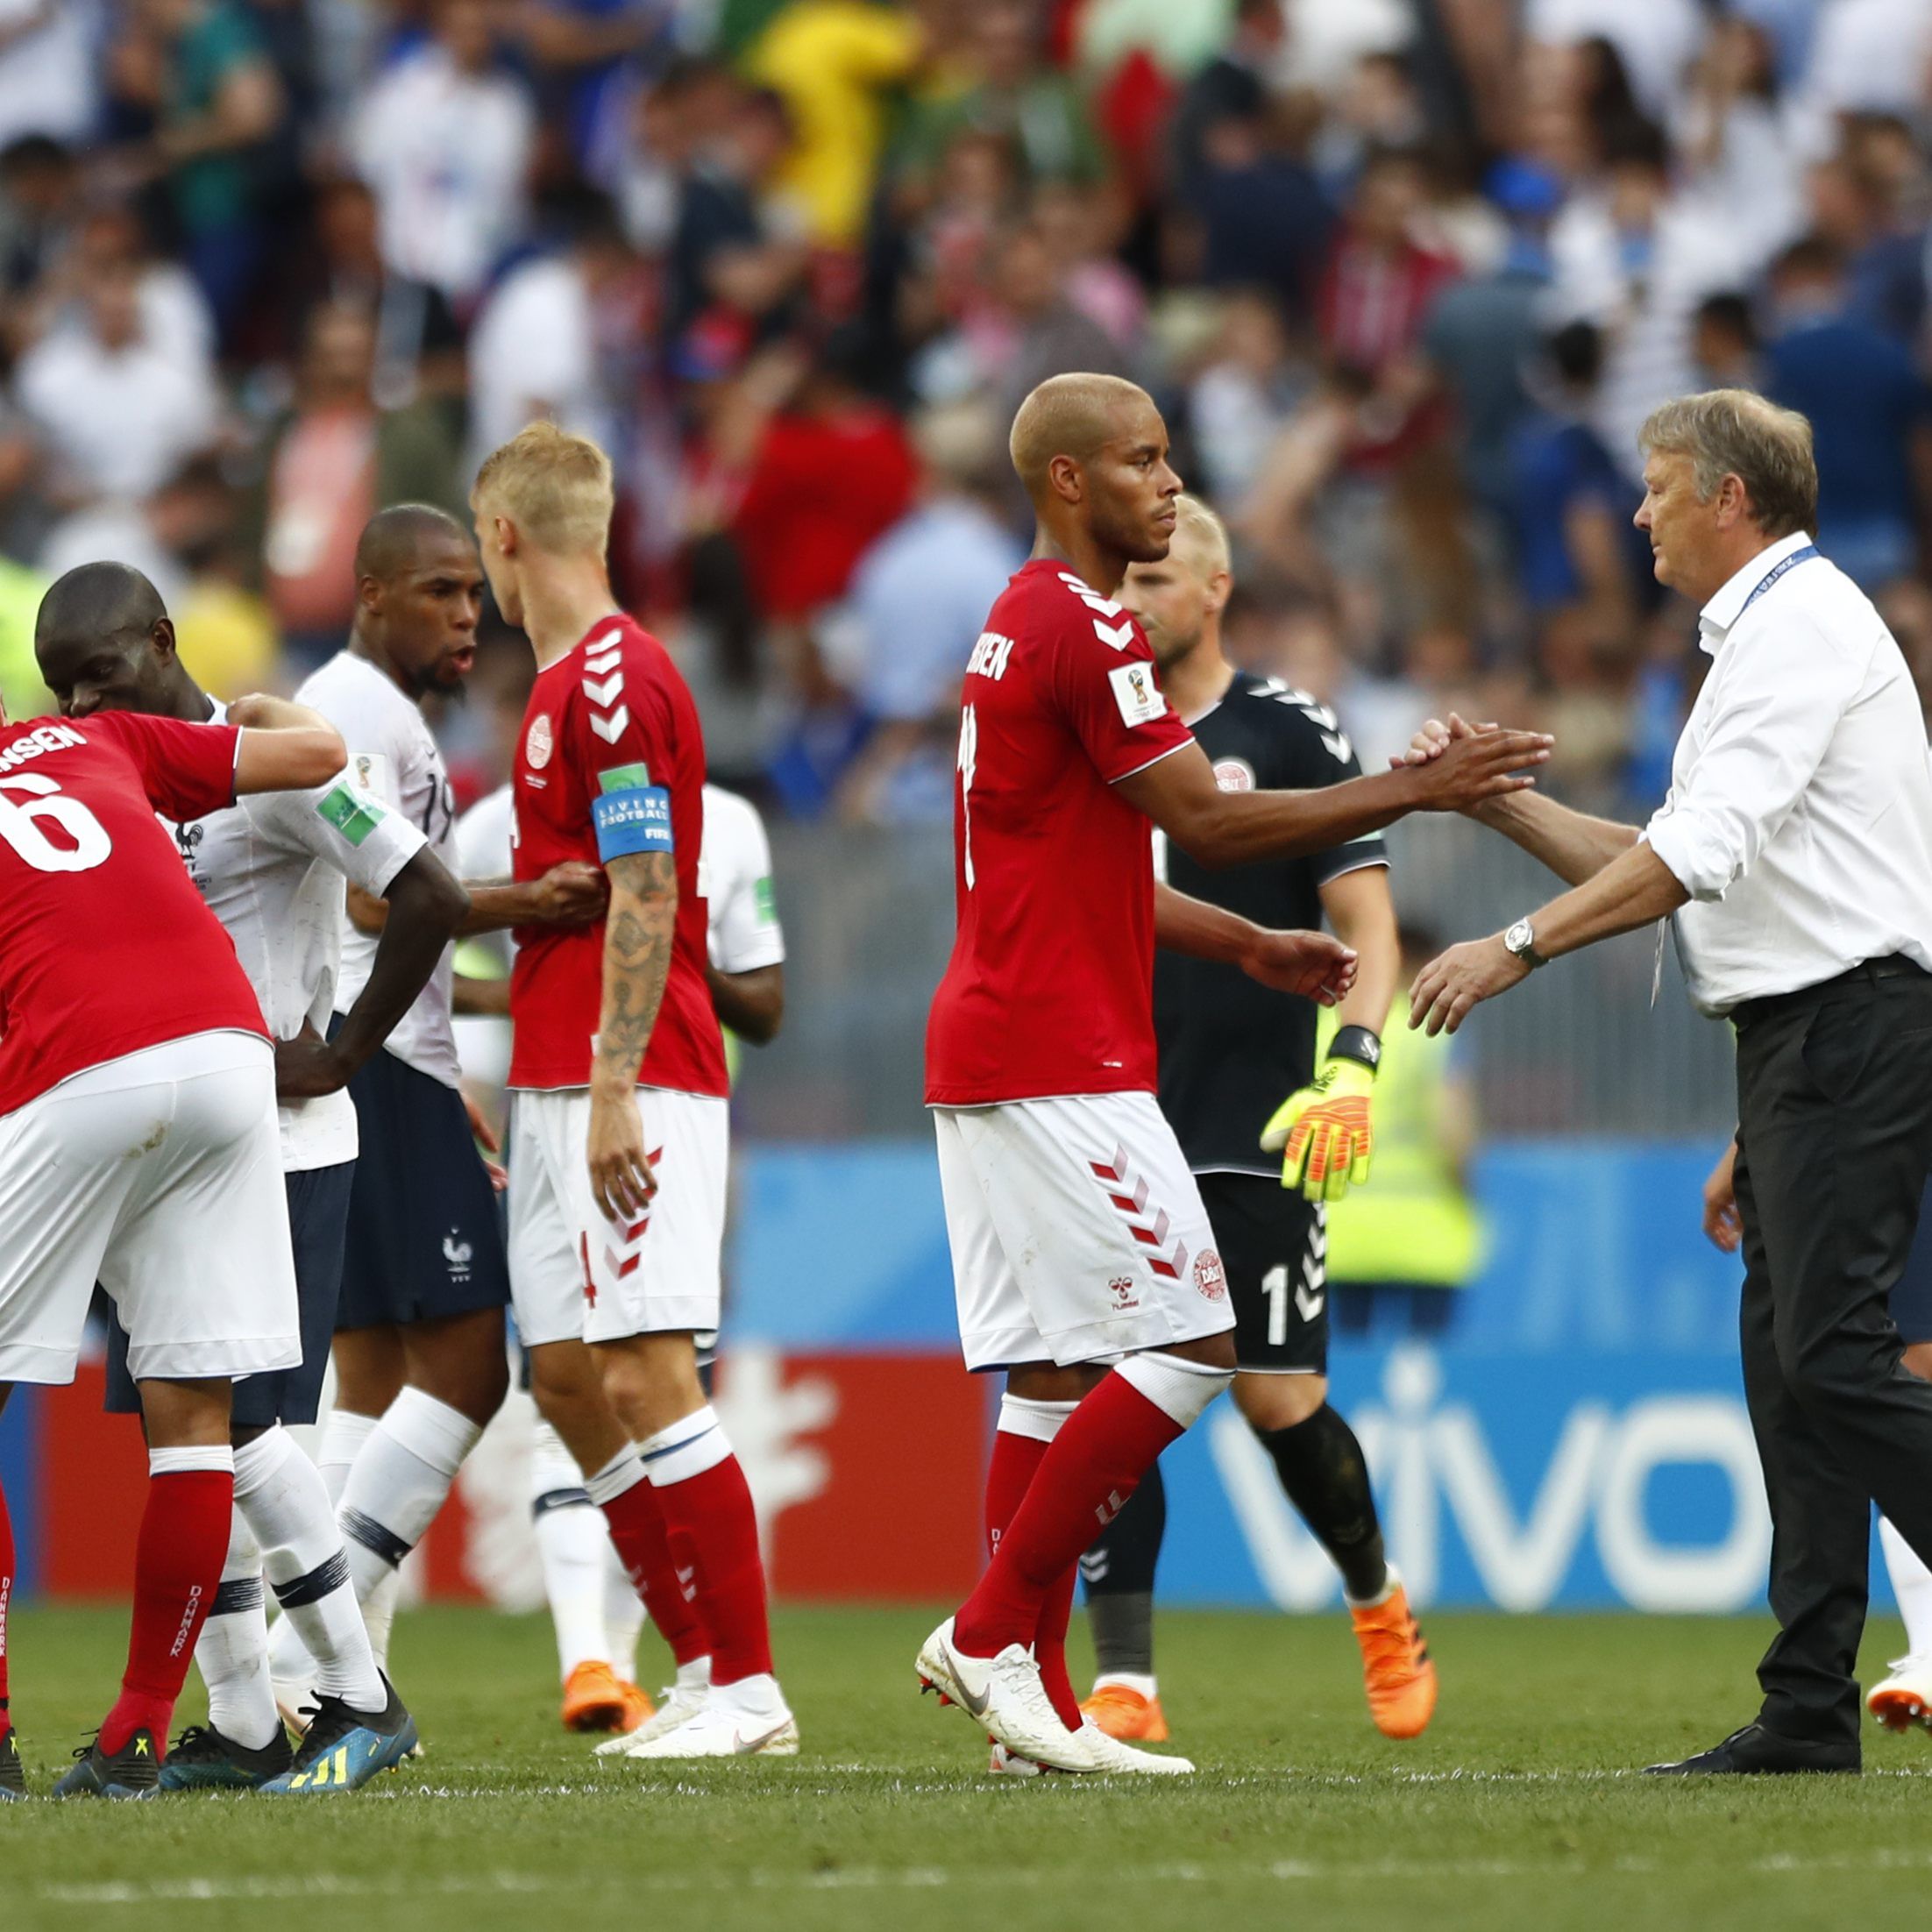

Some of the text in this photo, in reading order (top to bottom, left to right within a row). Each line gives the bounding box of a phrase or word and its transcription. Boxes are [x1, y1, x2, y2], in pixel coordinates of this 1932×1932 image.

[0, 724, 88, 772] NSEN
[0, 771, 113, 872] 6
[599, 799, 667, 819] LIVING
[600, 809, 668, 828] FOOTBALL
[1261, 1267, 1288, 1346] 1
[169, 1585, 202, 1658] DANMARK
